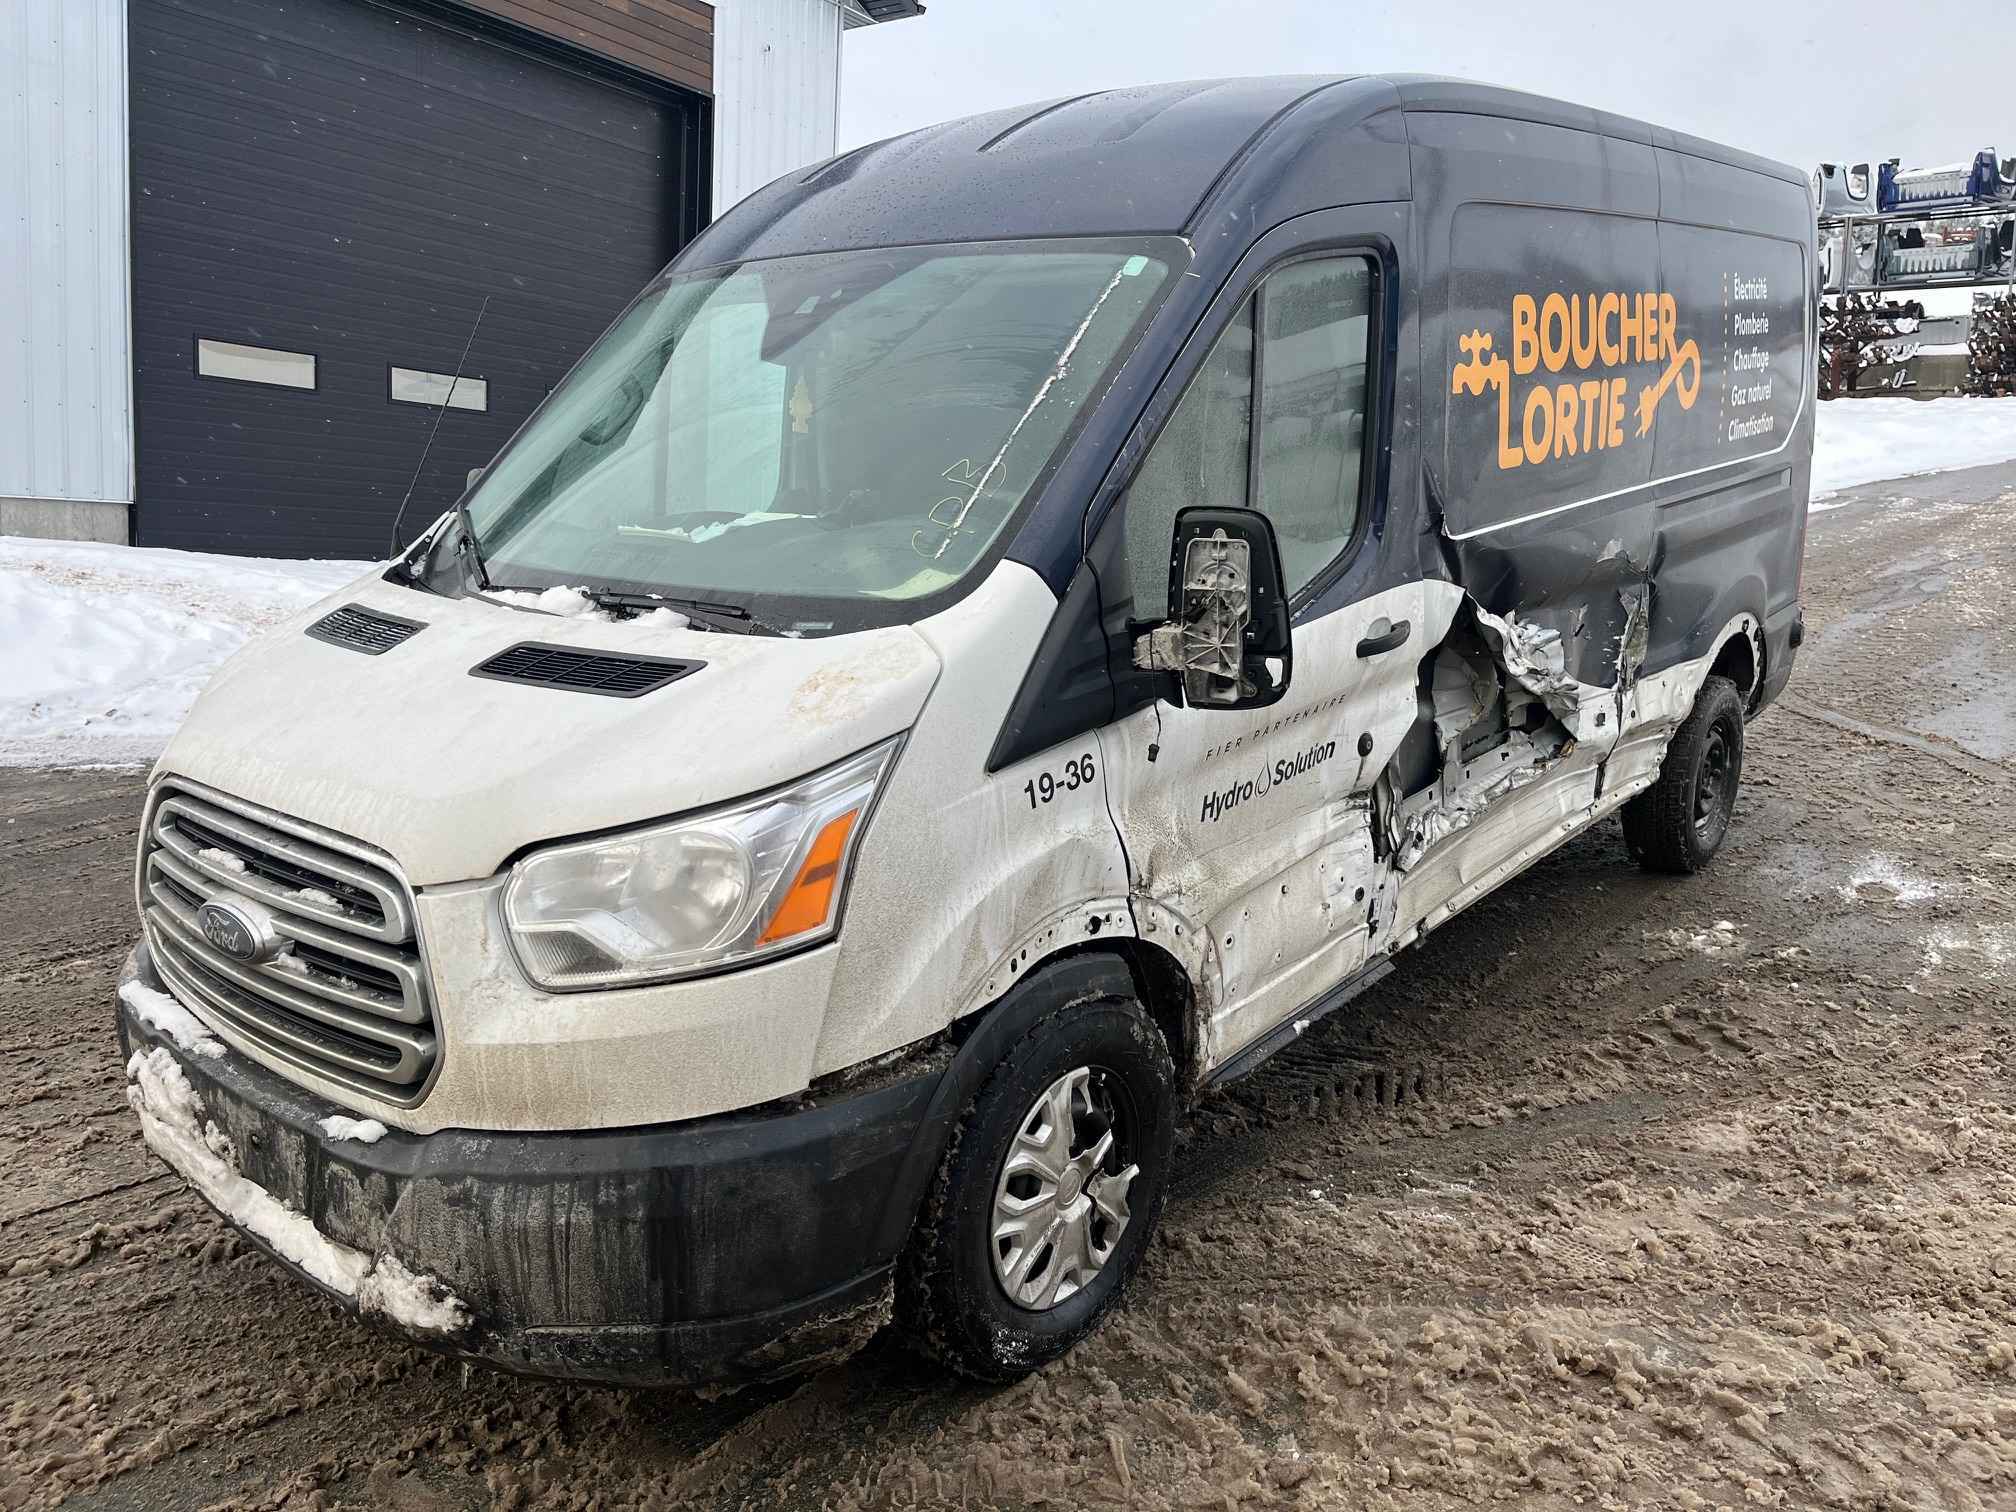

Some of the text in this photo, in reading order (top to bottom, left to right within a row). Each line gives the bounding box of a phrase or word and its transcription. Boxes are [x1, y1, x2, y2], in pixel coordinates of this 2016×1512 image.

[1734, 272, 1768, 300] Électricité
[1512, 292, 1678, 376] BOUCHER
[1734, 312, 1769, 336] Plomberie
[1733, 346, 1770, 373] Chauffage
[1731, 377, 1772, 407] Gaz naturel
[1498, 374, 1628, 470] LORTIE
[1728, 412, 1775, 442] Climatisation
[1205, 693, 1347, 761] FIER PARTENAIRE
[1023, 752, 1097, 810] 19-36
[1200, 738, 1337, 823] Hydro Solution
[204, 911, 240, 952] Ford
